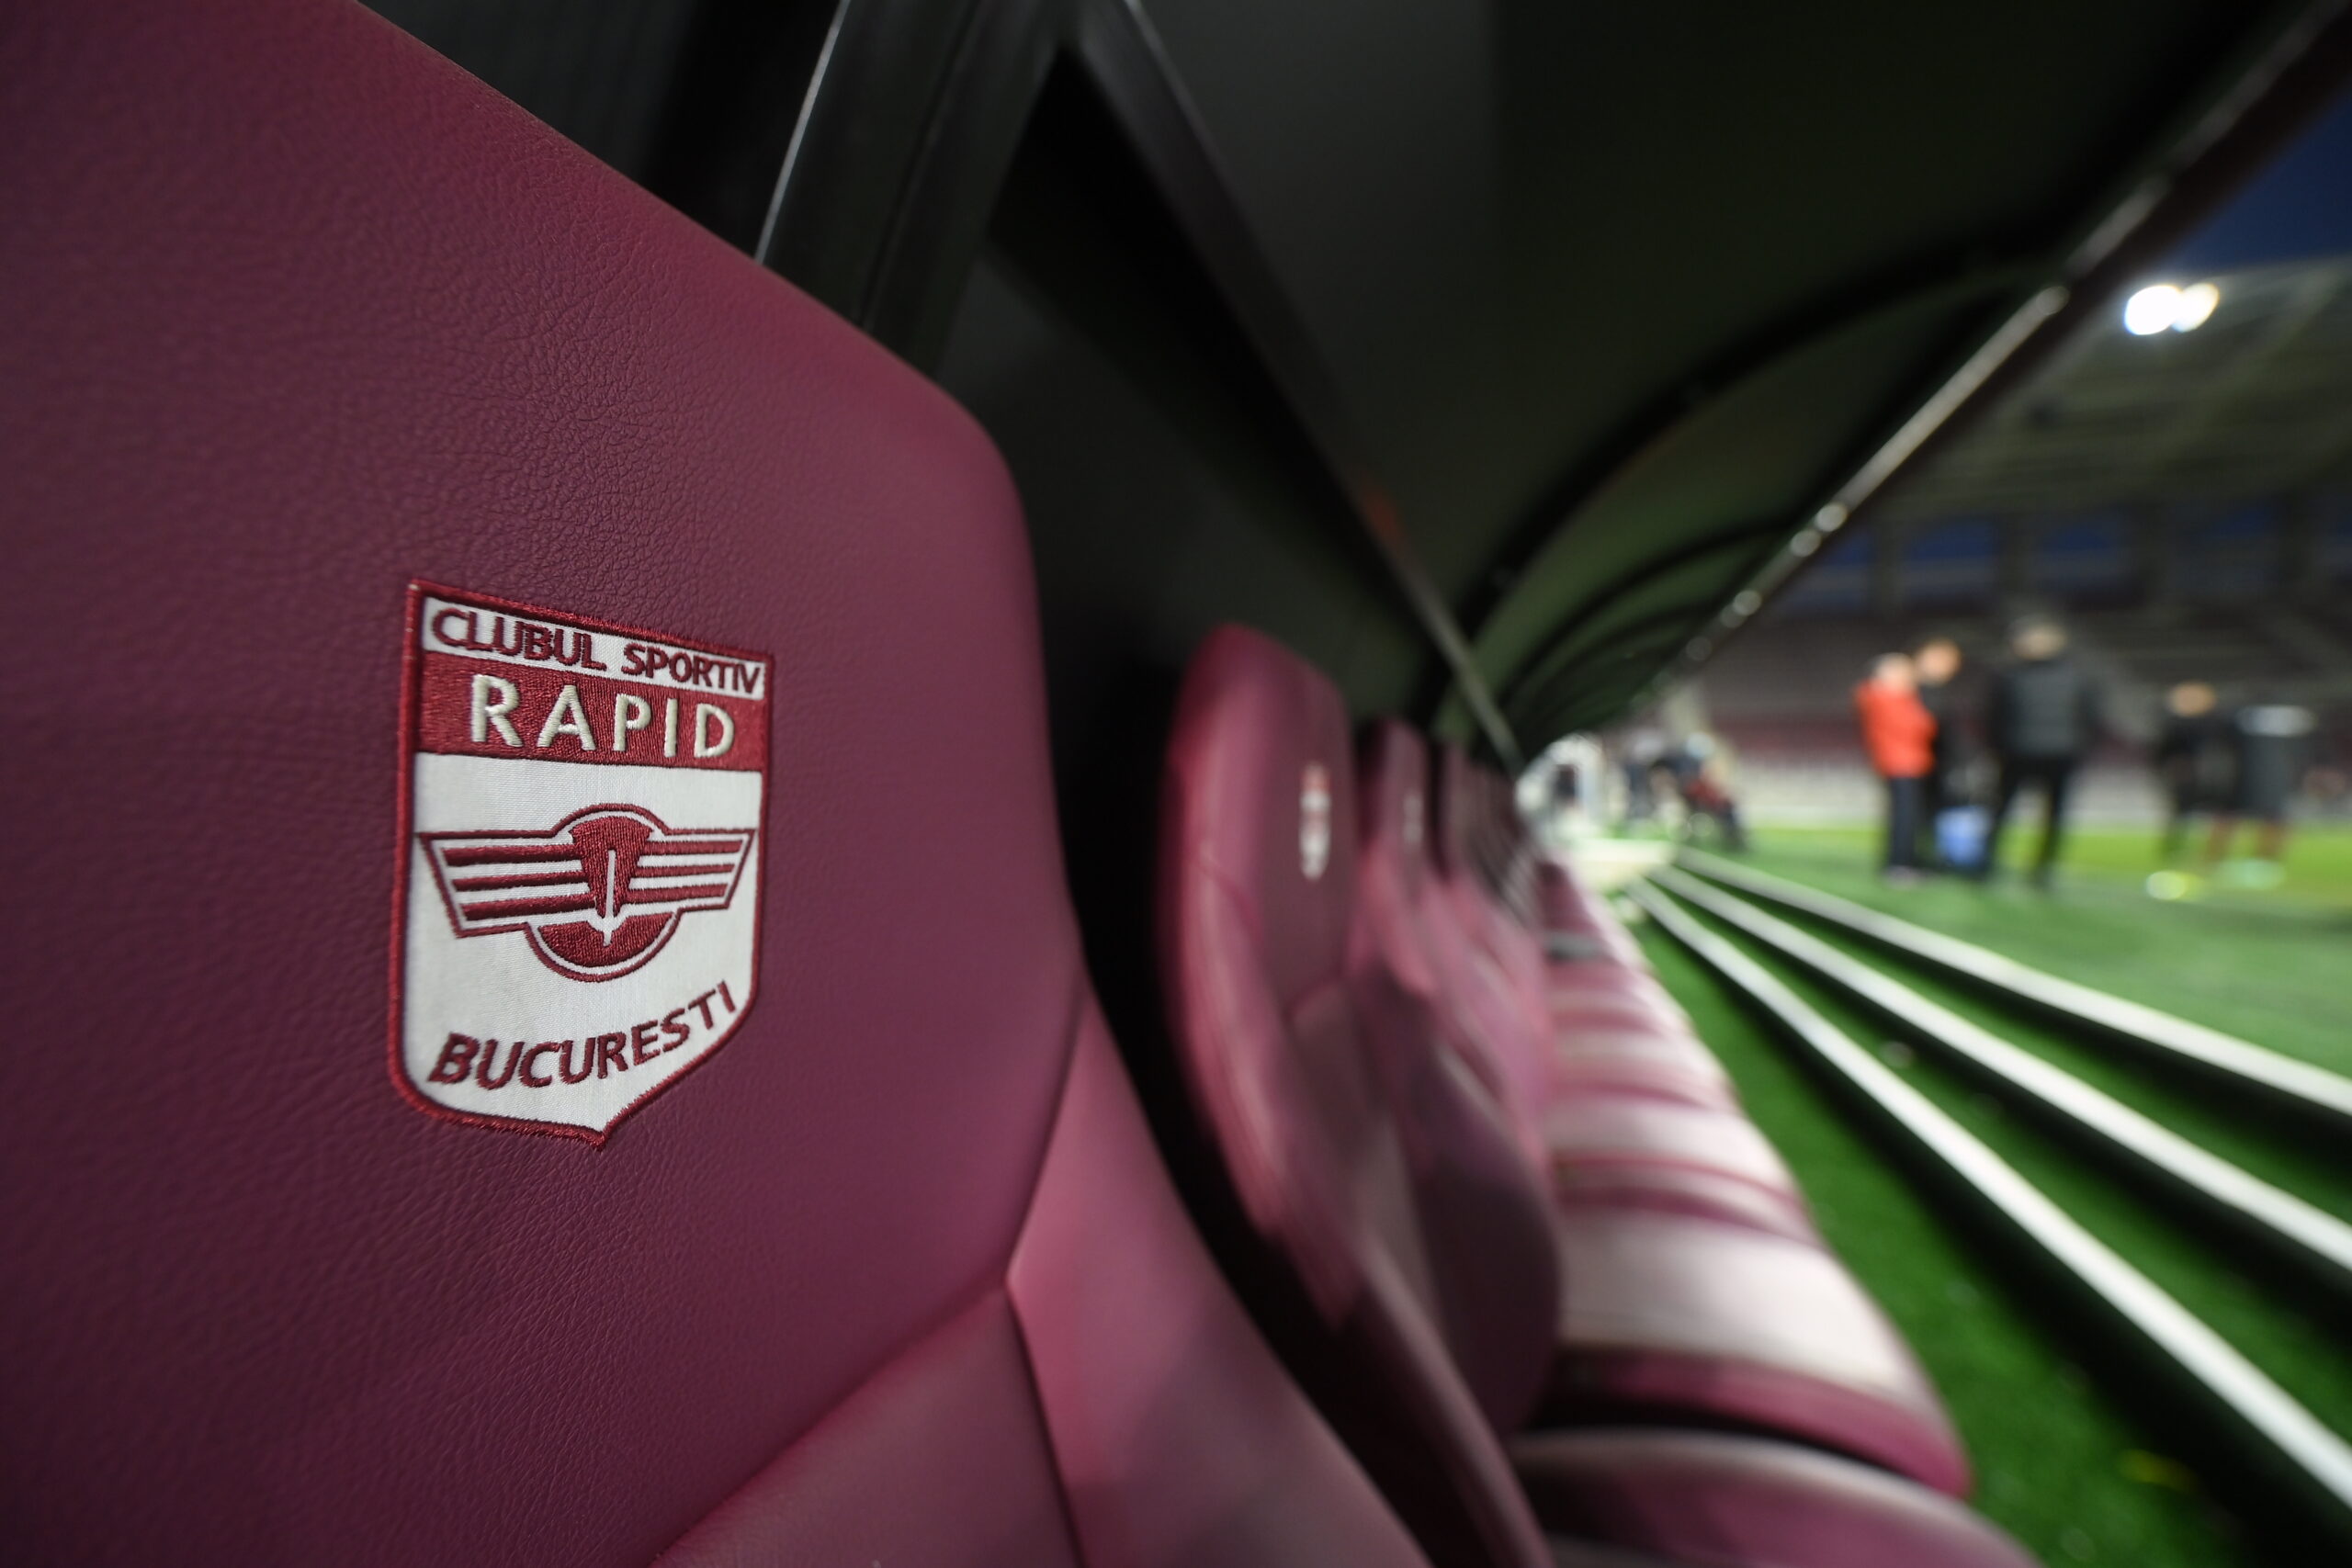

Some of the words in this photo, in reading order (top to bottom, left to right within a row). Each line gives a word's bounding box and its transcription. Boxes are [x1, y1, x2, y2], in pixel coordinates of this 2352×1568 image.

[432, 607, 607, 671] CLUBUL
[621, 642, 761, 694] SPORTIV
[471, 673, 735, 758] RAPID
[428, 980, 736, 1090] BUCURESTI
